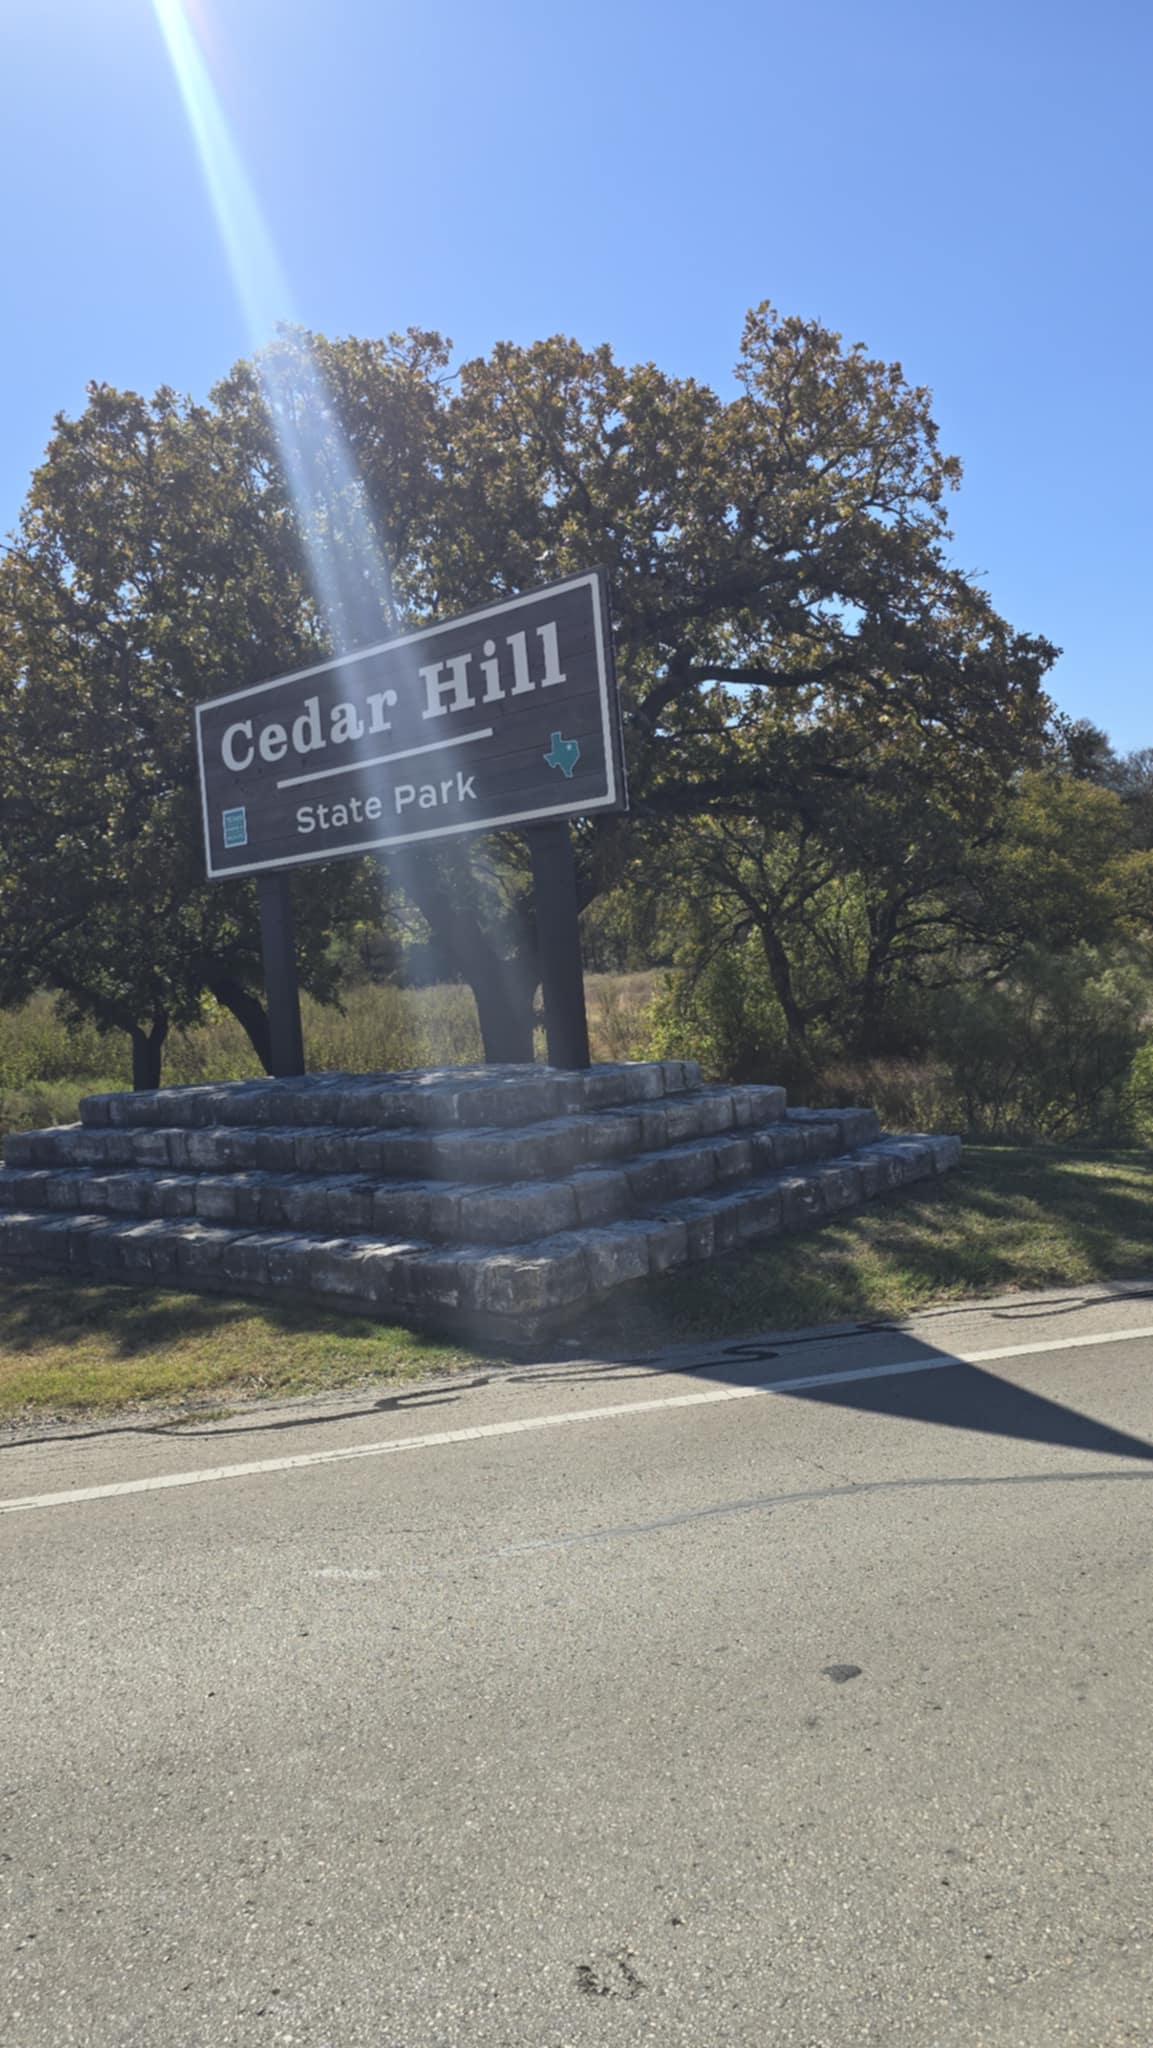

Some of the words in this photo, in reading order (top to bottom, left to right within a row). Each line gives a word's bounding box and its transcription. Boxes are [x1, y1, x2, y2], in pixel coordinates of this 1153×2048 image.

[221, 689, 398, 772] Cedar
[418, 621, 567, 720] Hill
[296, 795, 381, 834] State
[394, 771, 477, 814] Park
